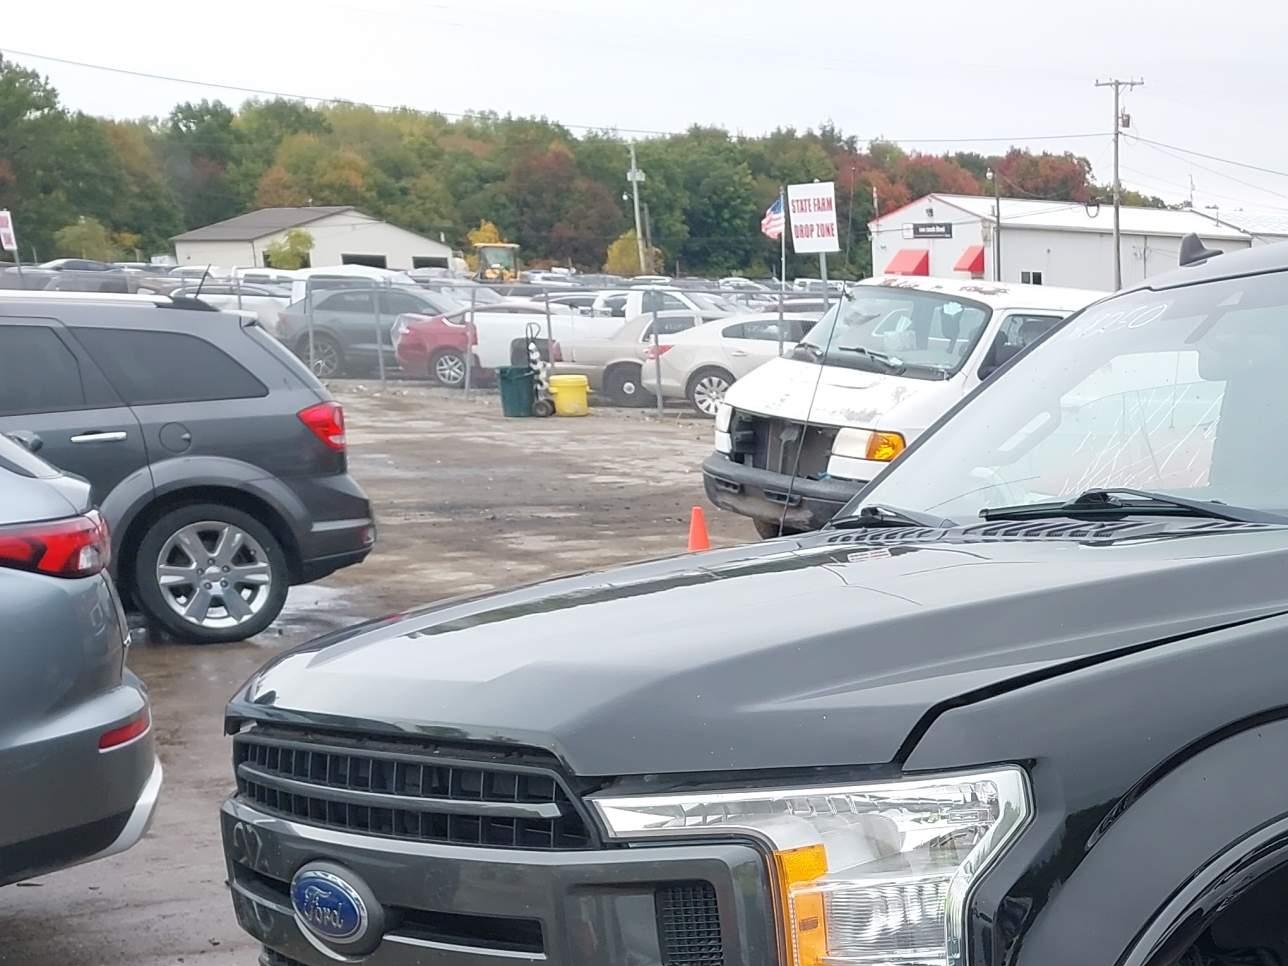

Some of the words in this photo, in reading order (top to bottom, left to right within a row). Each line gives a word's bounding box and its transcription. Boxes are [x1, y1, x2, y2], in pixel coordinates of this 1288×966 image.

[791, 198, 812, 213] STATE
[813, 196, 833, 212] FARM
[793, 223, 815, 239] DROP
[816, 222, 835, 238] ZONE
[303, 885, 345, 929] Ford
